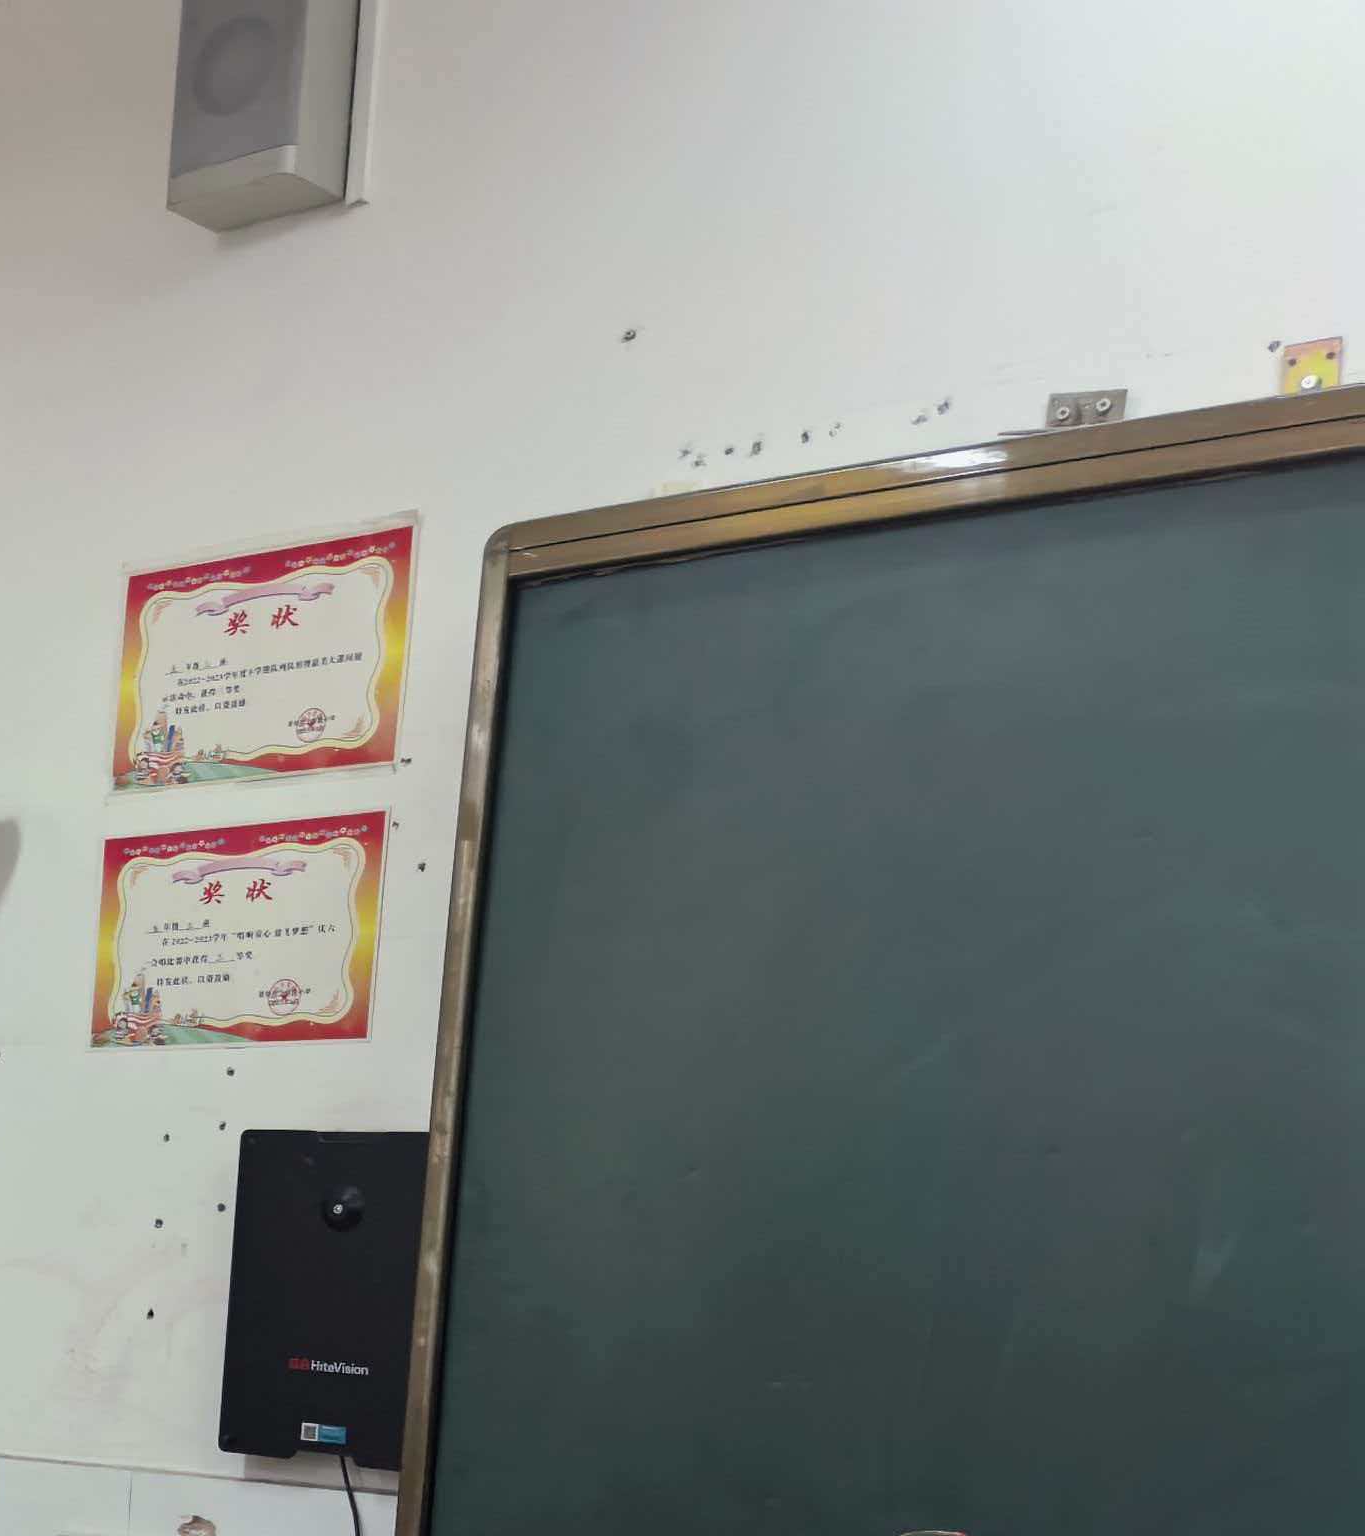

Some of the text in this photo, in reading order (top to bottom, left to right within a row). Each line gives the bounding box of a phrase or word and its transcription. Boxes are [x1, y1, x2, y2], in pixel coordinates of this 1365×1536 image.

[223, 604, 301, 637] 奖状
[198, 878, 274, 904] 奖状
[310, 1359, 369, 1375] HiteVision
